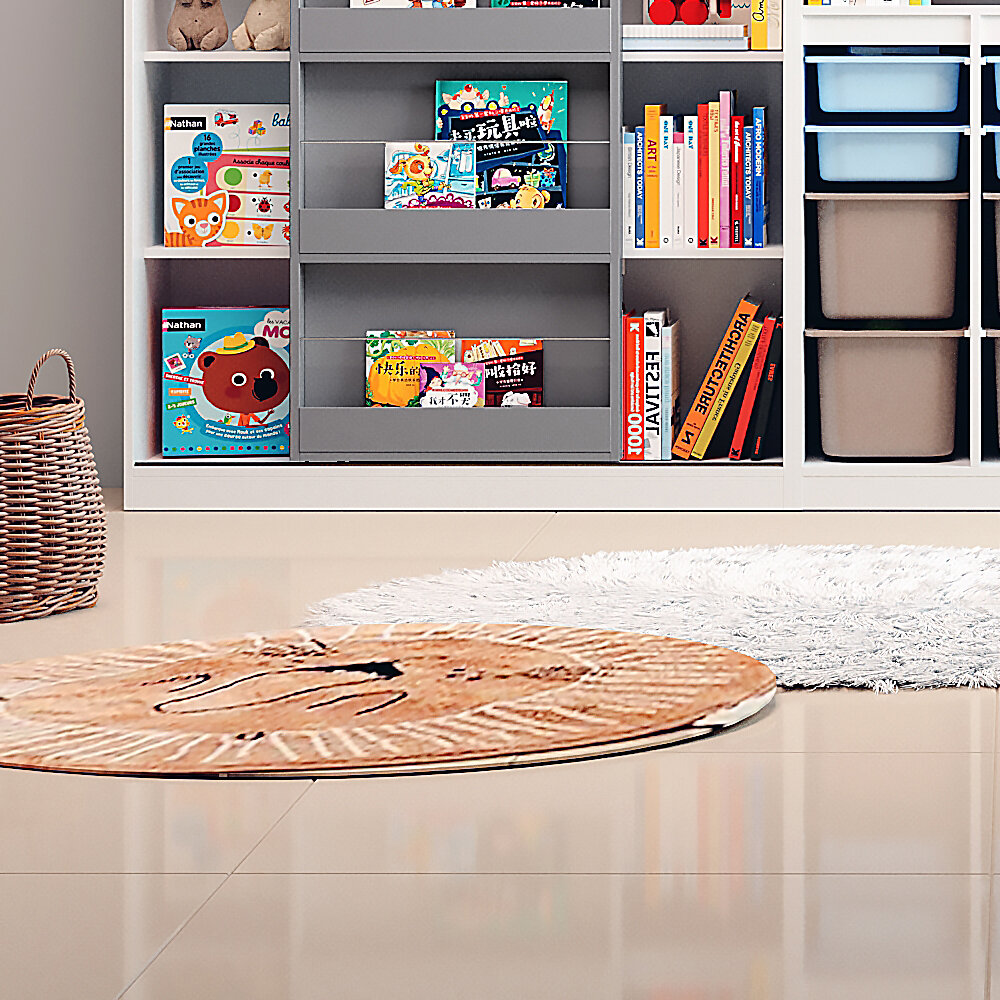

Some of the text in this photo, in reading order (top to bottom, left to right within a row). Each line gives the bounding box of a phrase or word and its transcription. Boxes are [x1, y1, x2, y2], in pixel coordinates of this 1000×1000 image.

[170, 119, 203, 128] Nathan
[647, 139, 657, 161] ART
[262, 325, 290, 339] MO
